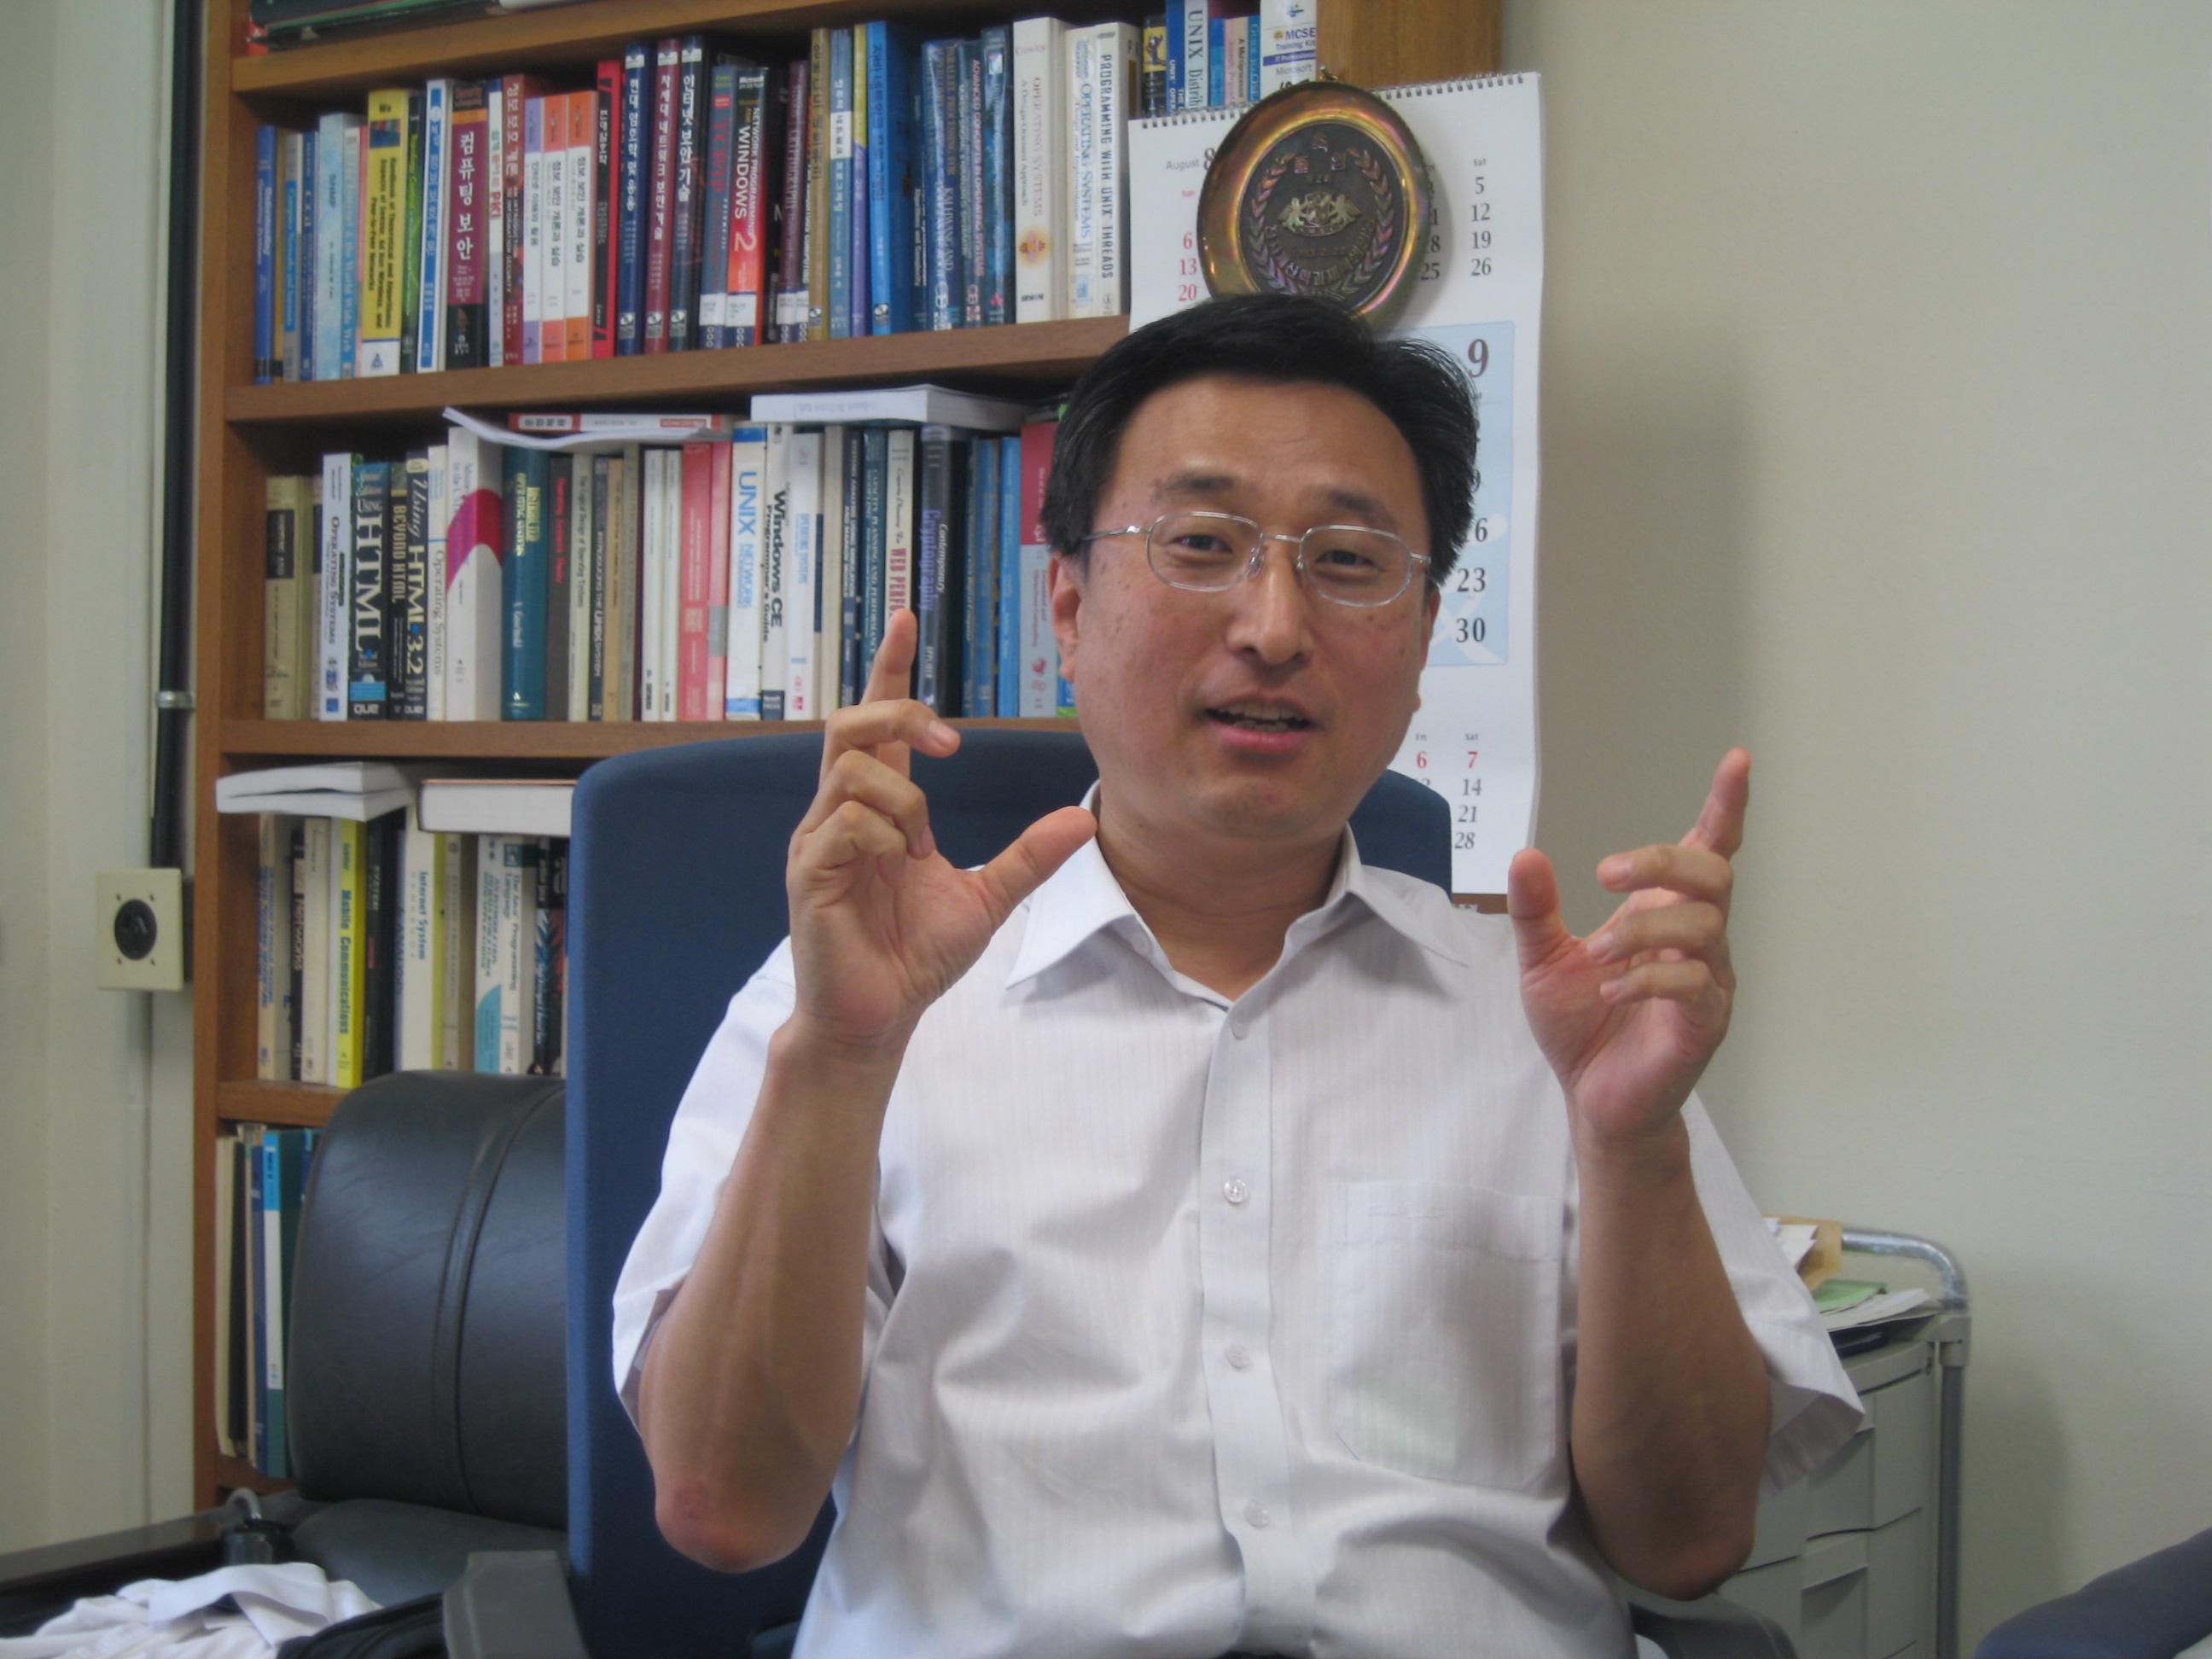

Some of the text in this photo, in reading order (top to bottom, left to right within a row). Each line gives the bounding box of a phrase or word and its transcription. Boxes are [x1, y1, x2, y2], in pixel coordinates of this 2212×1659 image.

[1285, 27, 1316, 41] MCSE
[1187, 9, 1204, 108] UNIX Distrib
[1276, 64, 1313, 76] Microsoft
[682, 74, 696, 126] 인터넷
[972, 60, 981, 110] ADVANCED
[973, 112, 981, 164] CONCEPTS
[1080, 83, 1093, 167] OPERATING
[576, 156, 587, 177] 정보
[680, 130, 693, 165] 보안
[1031, 77, 1044, 217] OPERATING SYSTEMS
[1099, 54, 1114, 278] PROGRAMMING WITH UNIX THREADS
[1166, 159, 1200, 172] August
[1474, 158, 1487, 167] Sat
[457, 131, 475, 207] 컴퓨팅
[552, 160, 562, 182] 정보
[678, 168, 693, 202] 기술
[734, 125, 752, 220] WINDOWS
[748, 108, 760, 236] NETWORK PROGRAMMING
[1021, 163, 1030, 207] Approach
[1475, 176, 1485, 195] 5
[490, 191, 503, 218] PKI
[551, 185, 562, 207] 보안
[576, 181, 586, 202] 보안
[1080, 171, 1093, 238] SYSTEMS
[1470, 203, 1491, 222] 12
[385, 157, 397, 329] Handbook Theoretical Algorithmic
[456, 212, 474, 261] 보안
[574, 242, 585, 264] 실습
[734, 231, 758, 252] 2
[976, 233, 985, 277] SYSTEMS
[1183, 232, 1193, 250] 6
[1471, 230, 1492, 249] 19
[343, 183, 355, 352] Internet the World Wide Web
[550, 247, 561, 268] 실습
[1179, 257, 1492, 281] 13 25 26
[1178, 284, 1198, 302] 20
[1468, 338, 1489, 378] 9
[737, 471, 758, 536] UNIX
[392, 505, 407, 560] BEYOND
[555, 478, 568, 584] Operating Systems Theory
[577, 514, 587, 536] Design
[871, 515, 880, 562] PLANNING
[1474, 516, 1488, 543] 6
[330, 515, 341, 588] OPERATING
[576, 546, 587, 577] Operating
[771, 491, 787, 628] Windows CE
[890, 548, 906, 572] WEB
[918, 509, 942, 612] Cryptography
[936, 522, 949, 594] Contemporary
[355, 513, 383, 653] HTML
[391, 562, 407, 604] HTML
[406, 478, 428, 675] Using HTML 3.2
[576, 579, 586, 608] Systems
[1456, 567, 1487, 593] 23
[328, 591, 338, 645] SYSTEMS
[431, 550, 445, 676] Operating Systems
[870, 586, 878, 655] PERFORMANCE
[1031, 609, 1039, 647] Computing
[1455, 617, 1486, 643] 30
[1416, 732, 1479, 742] Fri Sat
[1416, 750, 1479, 769] 6 7
[1462, 777, 1482, 796] 14
[1458, 805, 1478, 824] 21
[1454, 831, 1476, 850] 28
[416, 870, 428, 960] Internet System
[339, 889, 352, 1034] Mobile Communications
[509, 923, 519, 991] Programming
